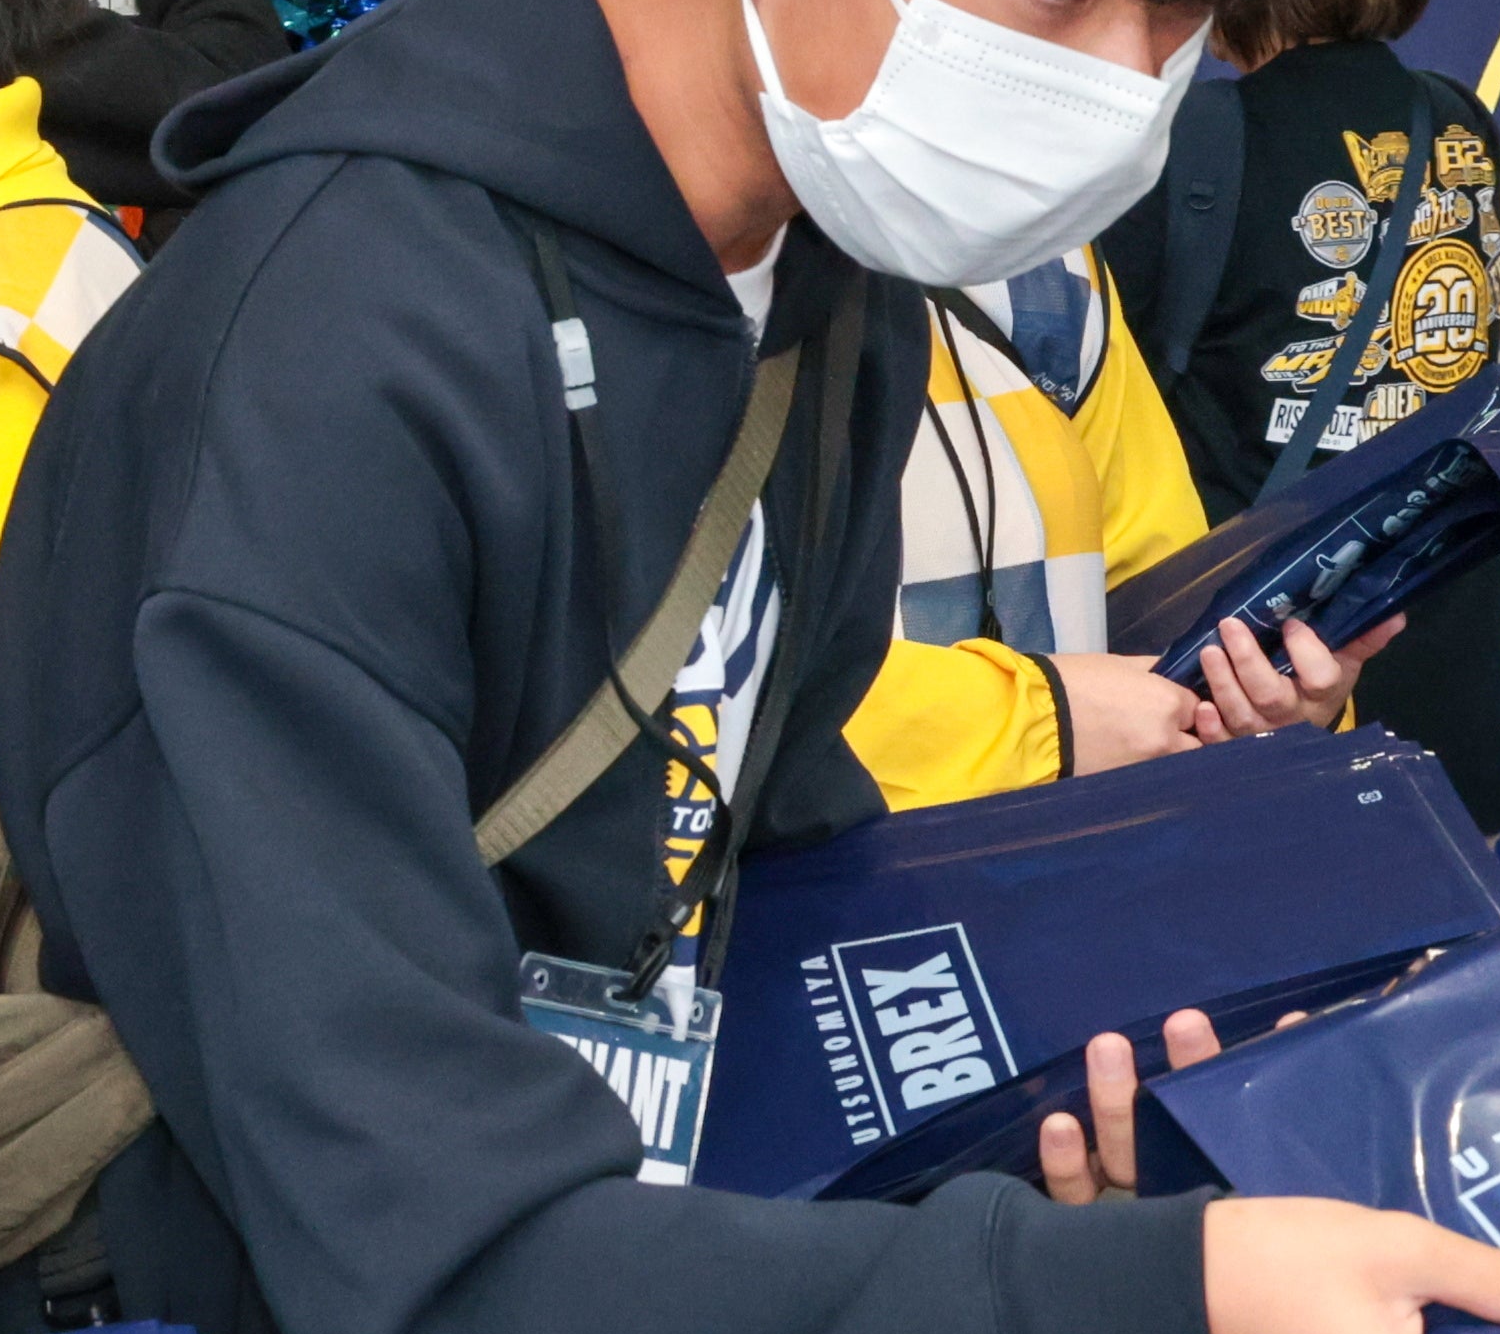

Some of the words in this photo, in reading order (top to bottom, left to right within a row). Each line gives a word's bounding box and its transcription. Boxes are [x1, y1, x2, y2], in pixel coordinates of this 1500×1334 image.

[1308, 210, 1367, 241] BEST
[1415, 278, 1476, 353] 20
[1415, 313, 1476, 333] ANNIVERSARY
[1289, 343, 1306, 353] TO
[1307, 338, 1336, 350] THE
[1275, 403, 1303, 430] RIS
[860, 951, 995, 1111] BREX
[799, 956, 884, 1146] UTSUNOMIYA
